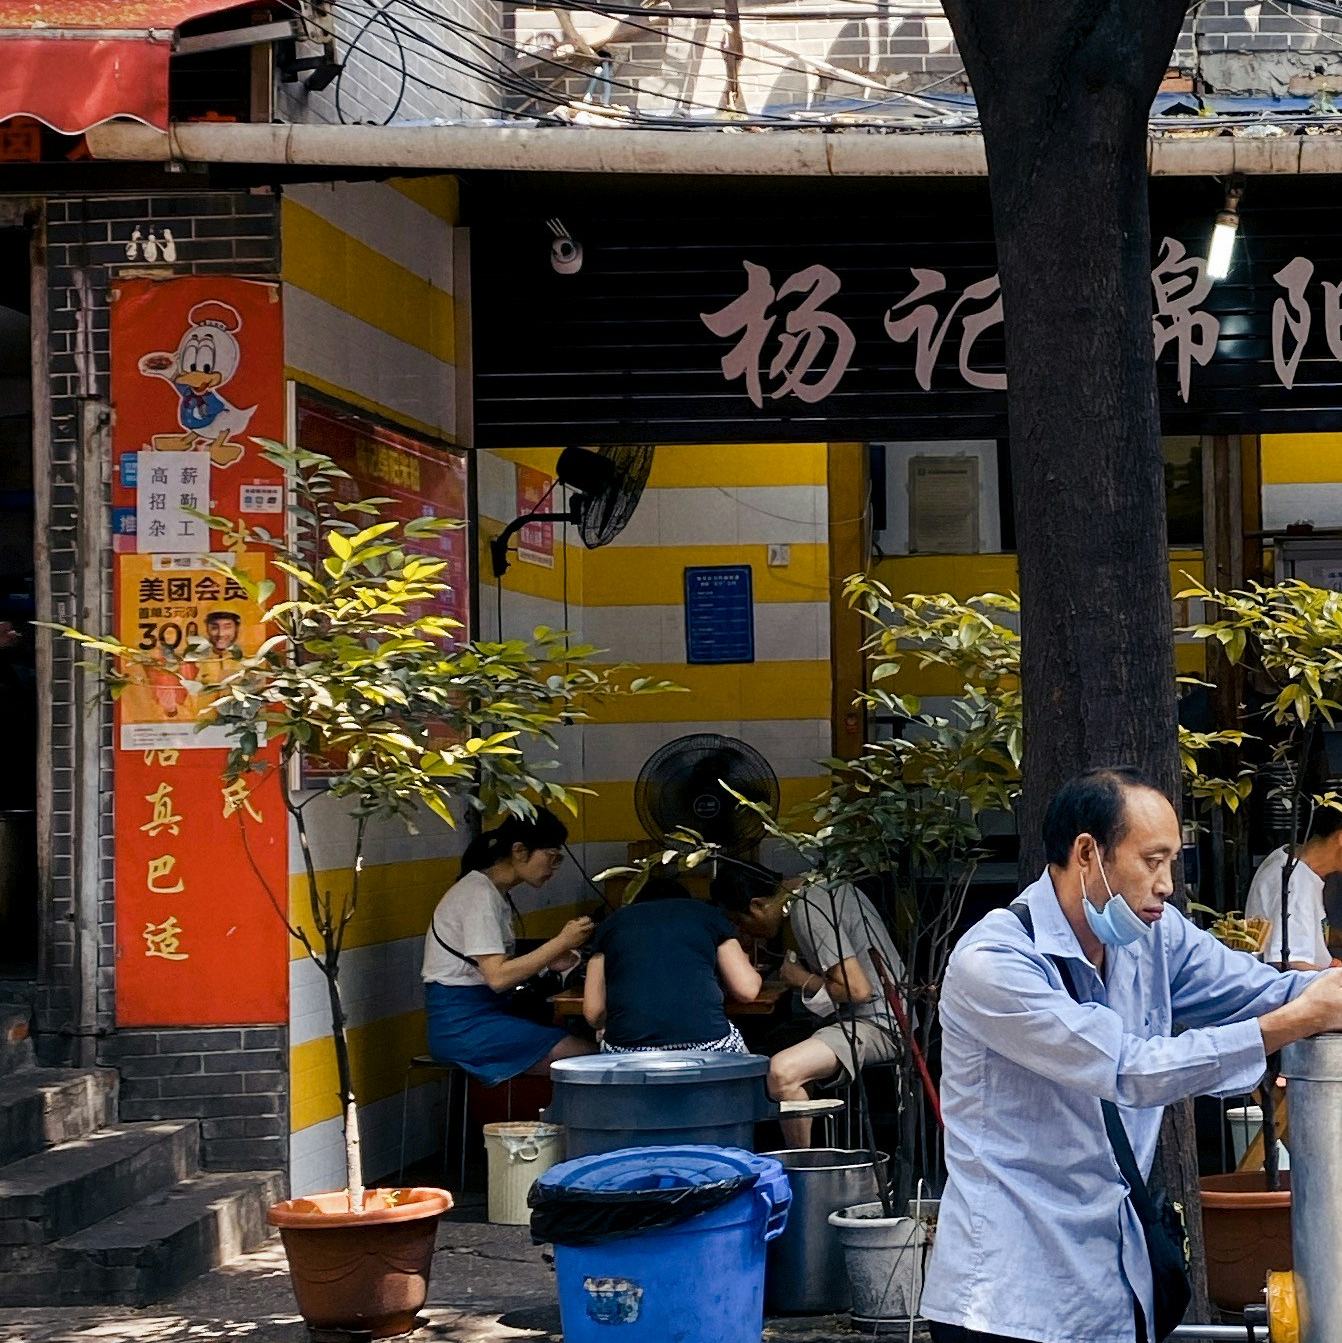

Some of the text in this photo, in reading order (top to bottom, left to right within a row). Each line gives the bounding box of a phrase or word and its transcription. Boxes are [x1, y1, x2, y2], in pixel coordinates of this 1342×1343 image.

[150, 466, 198, 485] 高薪
[149, 492, 198, 511] 招勤
[149, 519, 195, 538] 杂工
[139, 576, 250, 603] 美团会员
